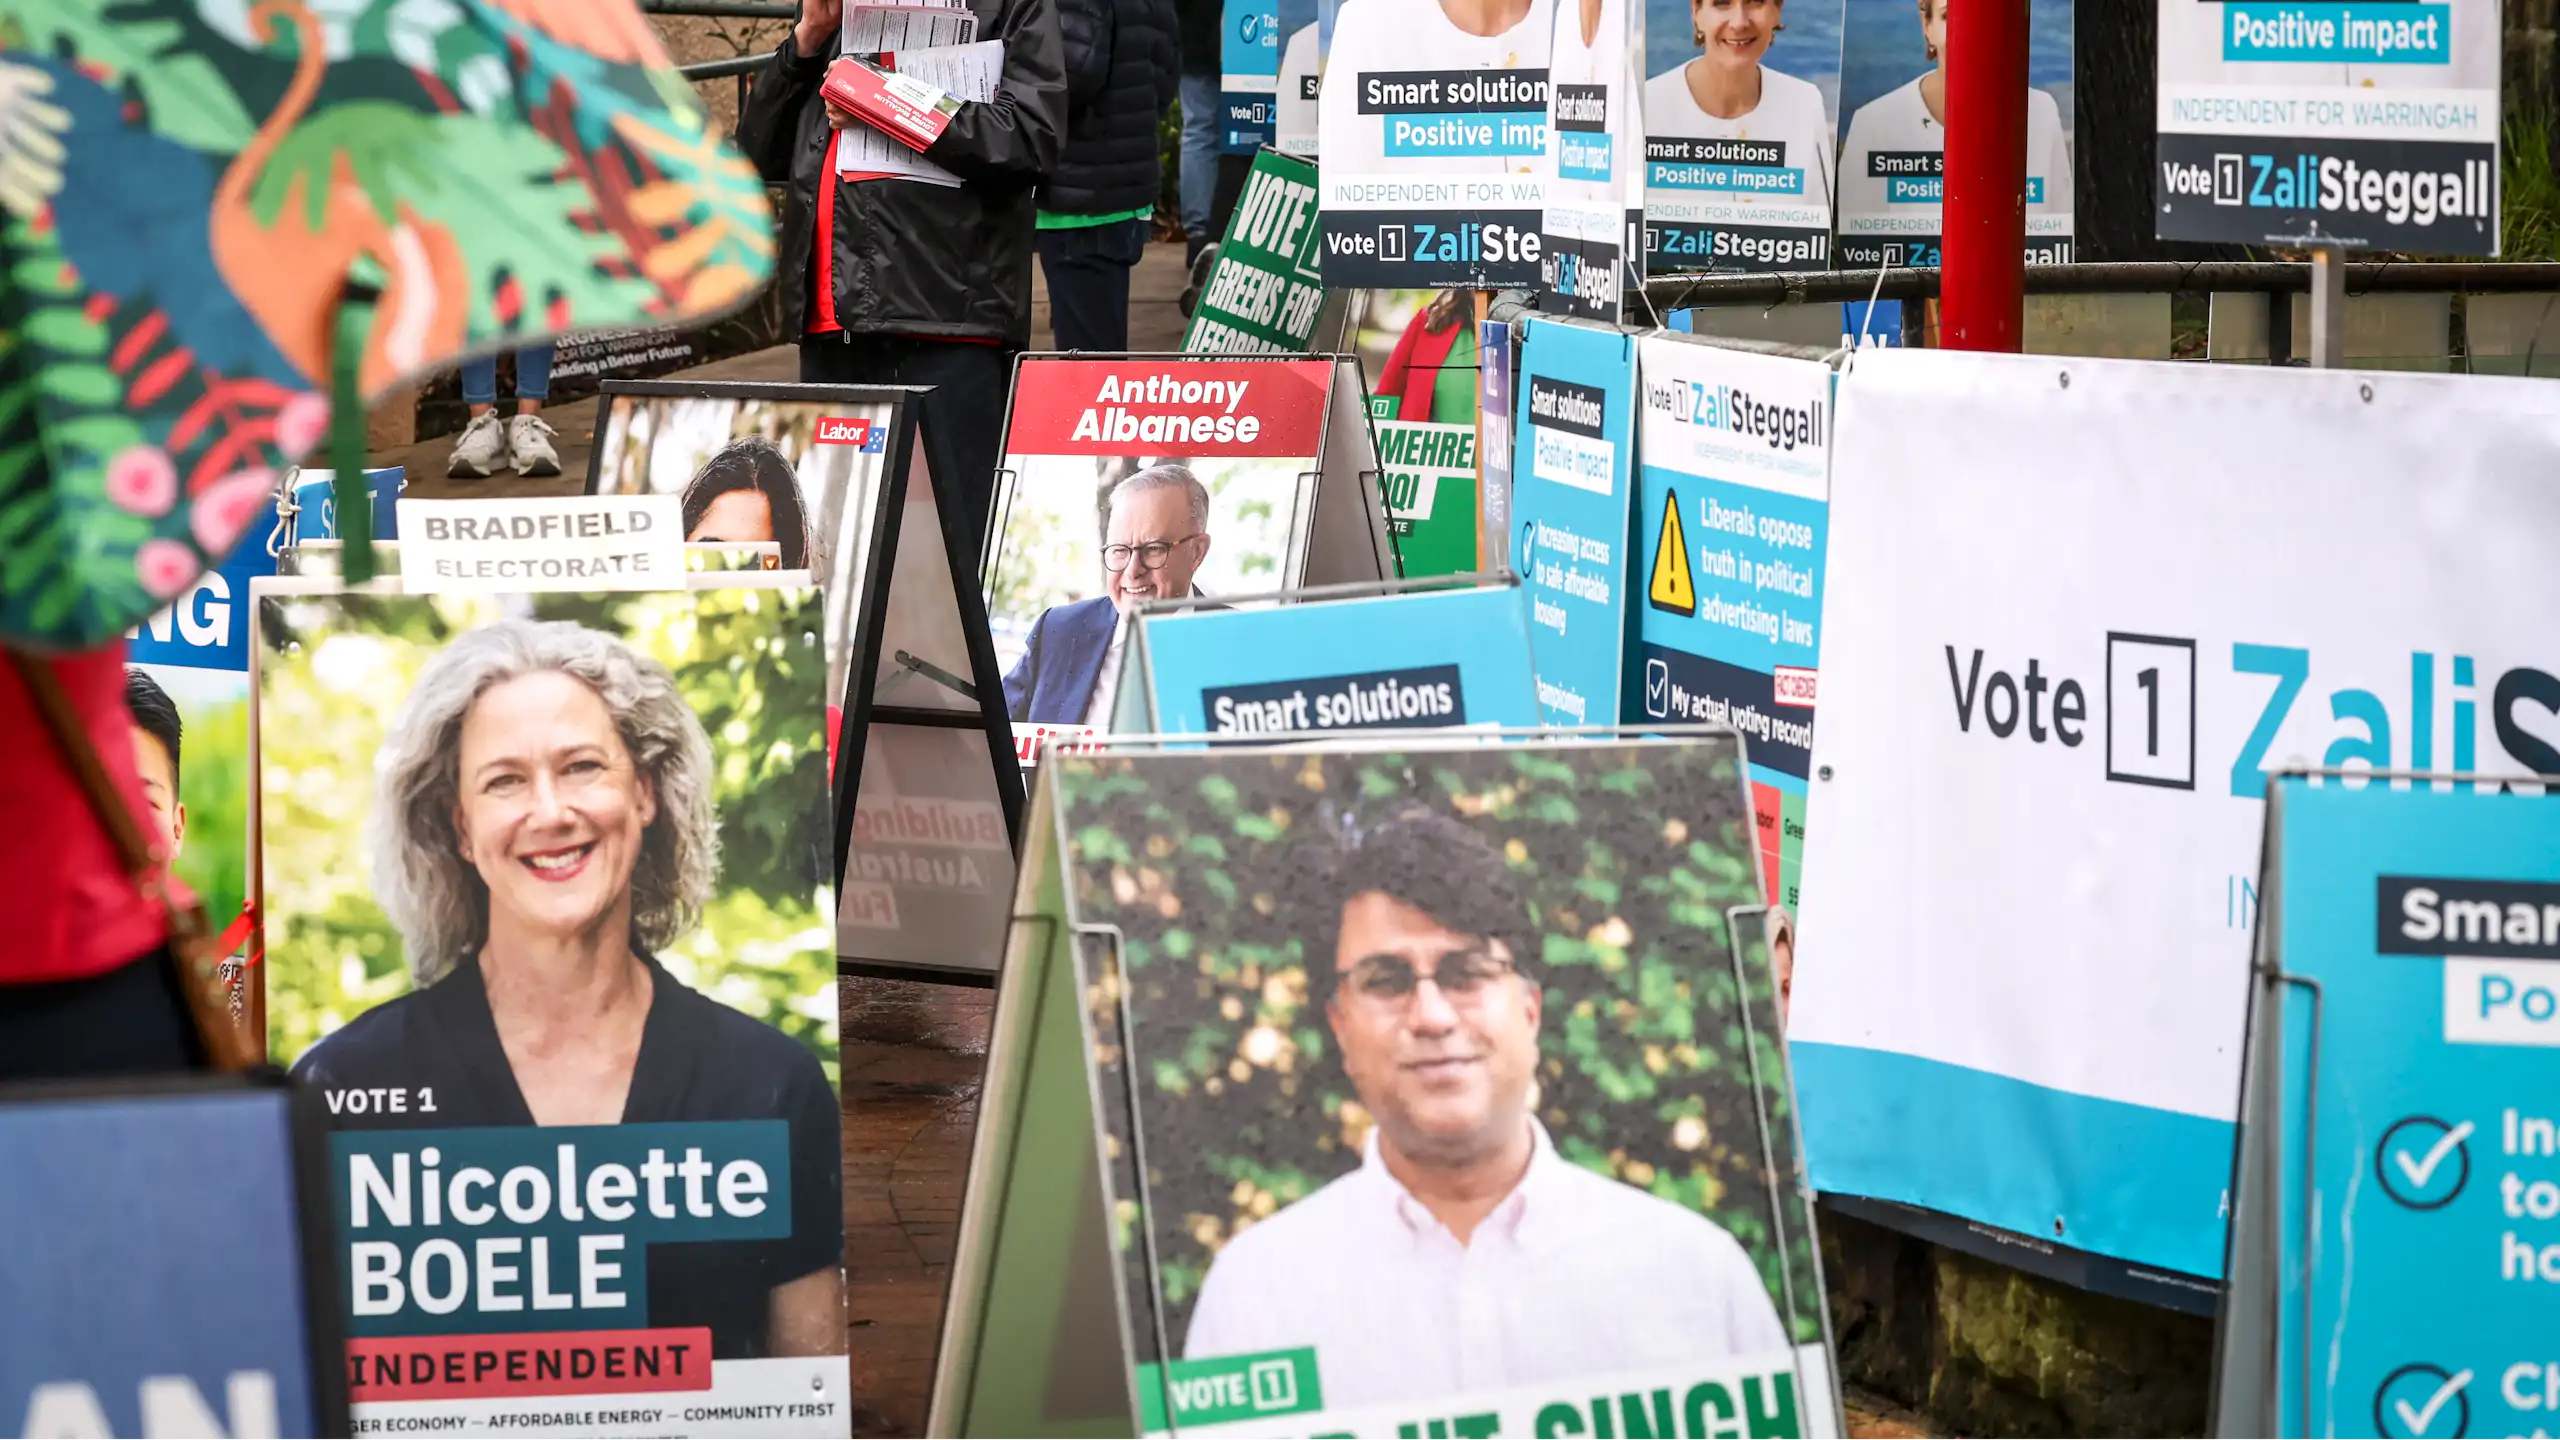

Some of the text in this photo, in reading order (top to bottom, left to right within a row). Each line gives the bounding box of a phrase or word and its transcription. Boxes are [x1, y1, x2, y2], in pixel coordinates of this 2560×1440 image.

[2233, 11, 2438, 56] Positive impact
[1367, 76, 1549, 105] Smart solution
[1556, 92, 1605, 122] Smart solutions
[1230, 106, 1252, 119] Vote
[2173, 98, 2478, 130] INDEPENDENT FOR WARRINGAH
[1395, 119, 1493, 147] Positive
[1695, 142, 1778, 162] solutions
[1875, 155, 1929, 172] Smart
[1335, 183, 1545, 201] INDEPENDENT FOR WA
[1655, 166, 1796, 190] Positive impact
[2163, 161, 2212, 195] Vote
[1233, 170, 1316, 259] VOTE
[1705, 206, 1732, 219] FOR
[1737, 209, 1820, 223] WARRINGAH
[1851, 219, 1942, 230] INDEPENDENT
[1327, 232, 1375, 255] Vote
[1844, 248, 1880, 263] Vote
[1206, 257, 1323, 340] GREENS FOR
[599, 359, 608, 370] a
[608, 351, 648, 369] Better
[649, 345, 692, 361] Future
[1096, 374, 1249, 413] Anthony
[1531, 384, 1601, 427] Smart solutions
[1646, 382, 1672, 411] Vote
[820, 422, 864, 440] Labor
[1071, 407, 1260, 443] Albanese
[1379, 428, 1475, 469] MEHRE
[1539, 435, 1573, 471] Positive
[1575, 442, 1609, 480] impact
[1378, 472, 1420, 512] QI
[425, 510, 653, 540] BRADFIELD
[1538, 519, 1610, 565] Increasing access
[1701, 497, 1812, 550] Liberals oppose
[436, 553, 650, 578] ELECTORATE
[1536, 558, 1610, 605] to safe affordable
[1701, 545, 1812, 598] truth in political
[1534, 594, 1566, 636] housing
[1701, 593, 1813, 647] advertising laws
[1214, 678, 1454, 737] Smart solutions
[1945, 645, 2086, 748] Vote
[1671, 684, 1812, 750] My actual voting record
[325, 1087, 437, 1115] VOTE 1
[2502, 1107, 2560, 1158] In
[349, 1143, 769, 1227] Nicolette
[351, 1234, 627, 1316] BOELE
[351, 1344, 691, 1387] INDEPENDENT
[1171, 1372, 1249, 1411] VOTE
[386, 1416, 466, 1432] ECONOMY
[489, 1411, 593, 1429] AFFORDABLE
[599, 1410, 662, 1425] ENERGY
[684, 1405, 782, 1422] COMMUNITY
[788, 1403, 835, 1418] FIRST
